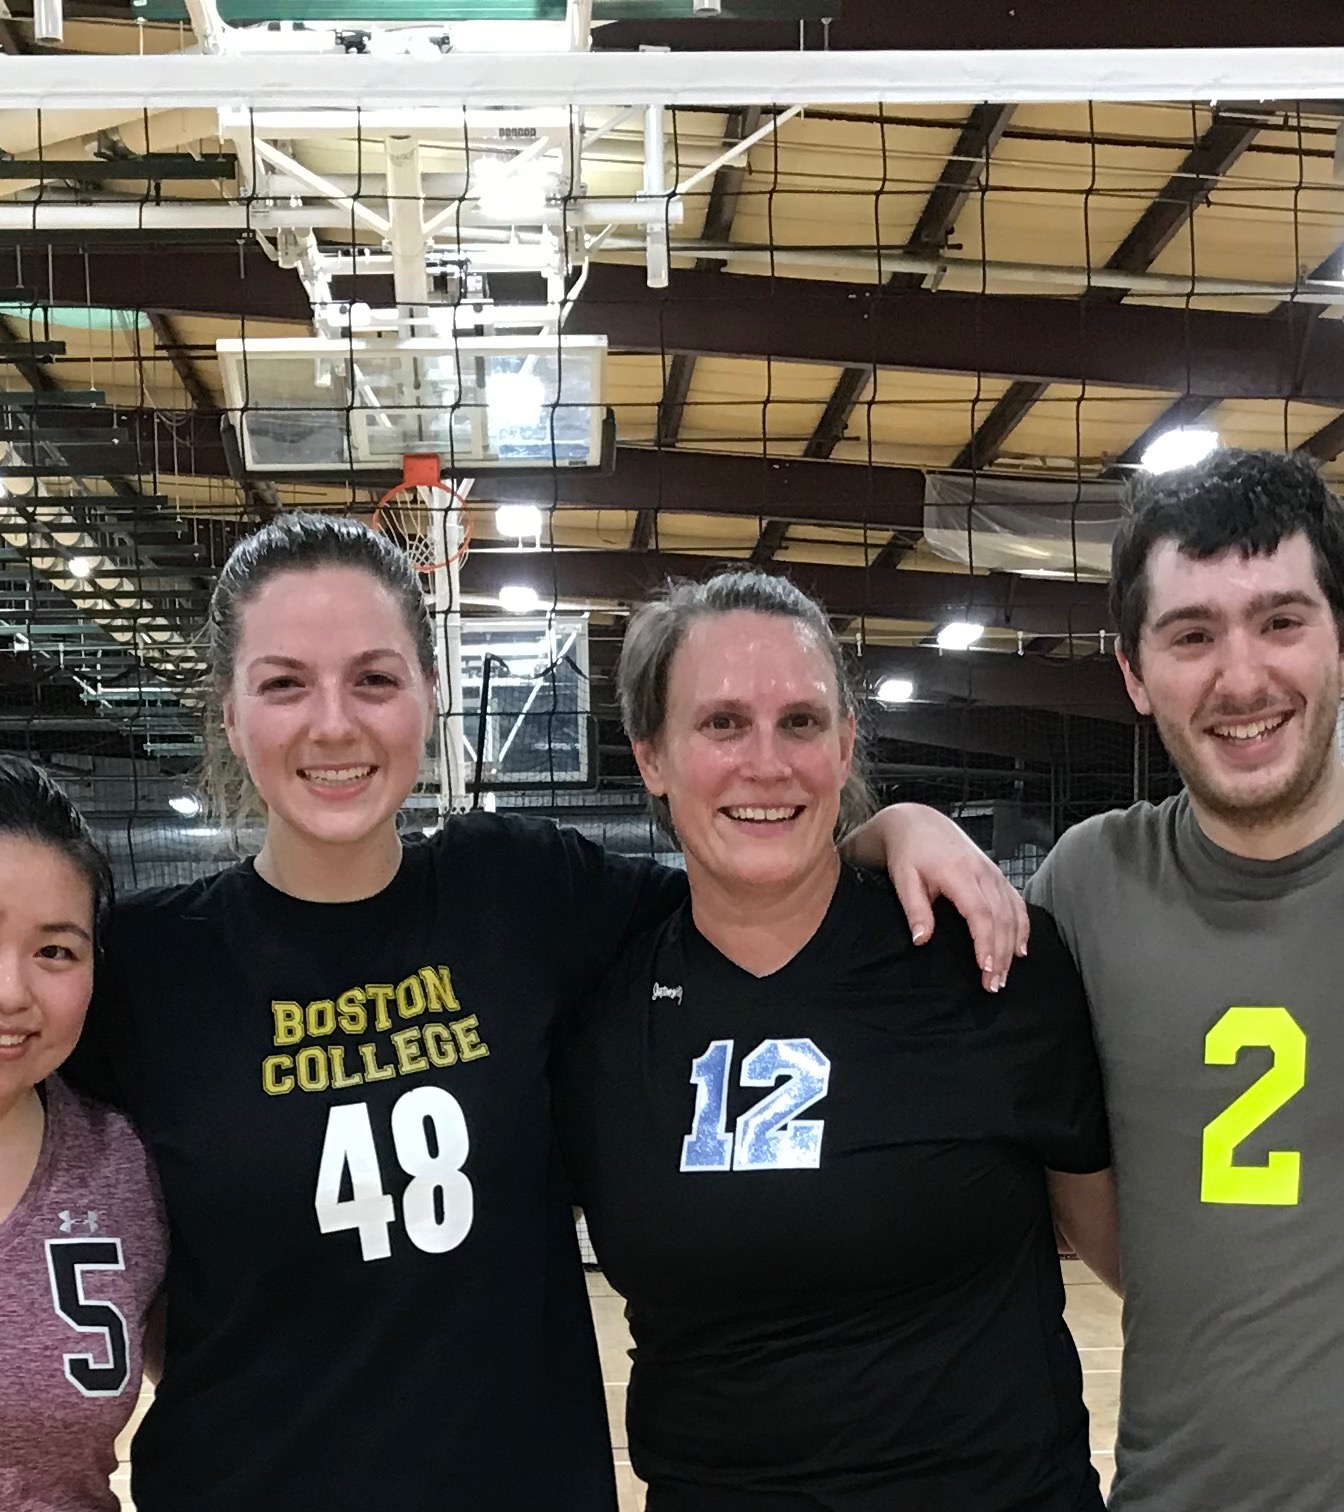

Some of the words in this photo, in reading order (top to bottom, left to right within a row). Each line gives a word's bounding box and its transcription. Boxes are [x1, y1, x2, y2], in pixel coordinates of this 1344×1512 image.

[262, 1014, 490, 1095] COLLEGE
[271, 965, 461, 1046] BOSTON
[314, 1086, 476, 1261] 48
[679, 1037, 832, 1173] 12
[1200, 1006, 1307, 1205] 2
[45, 1237, 131, 1398] 5
